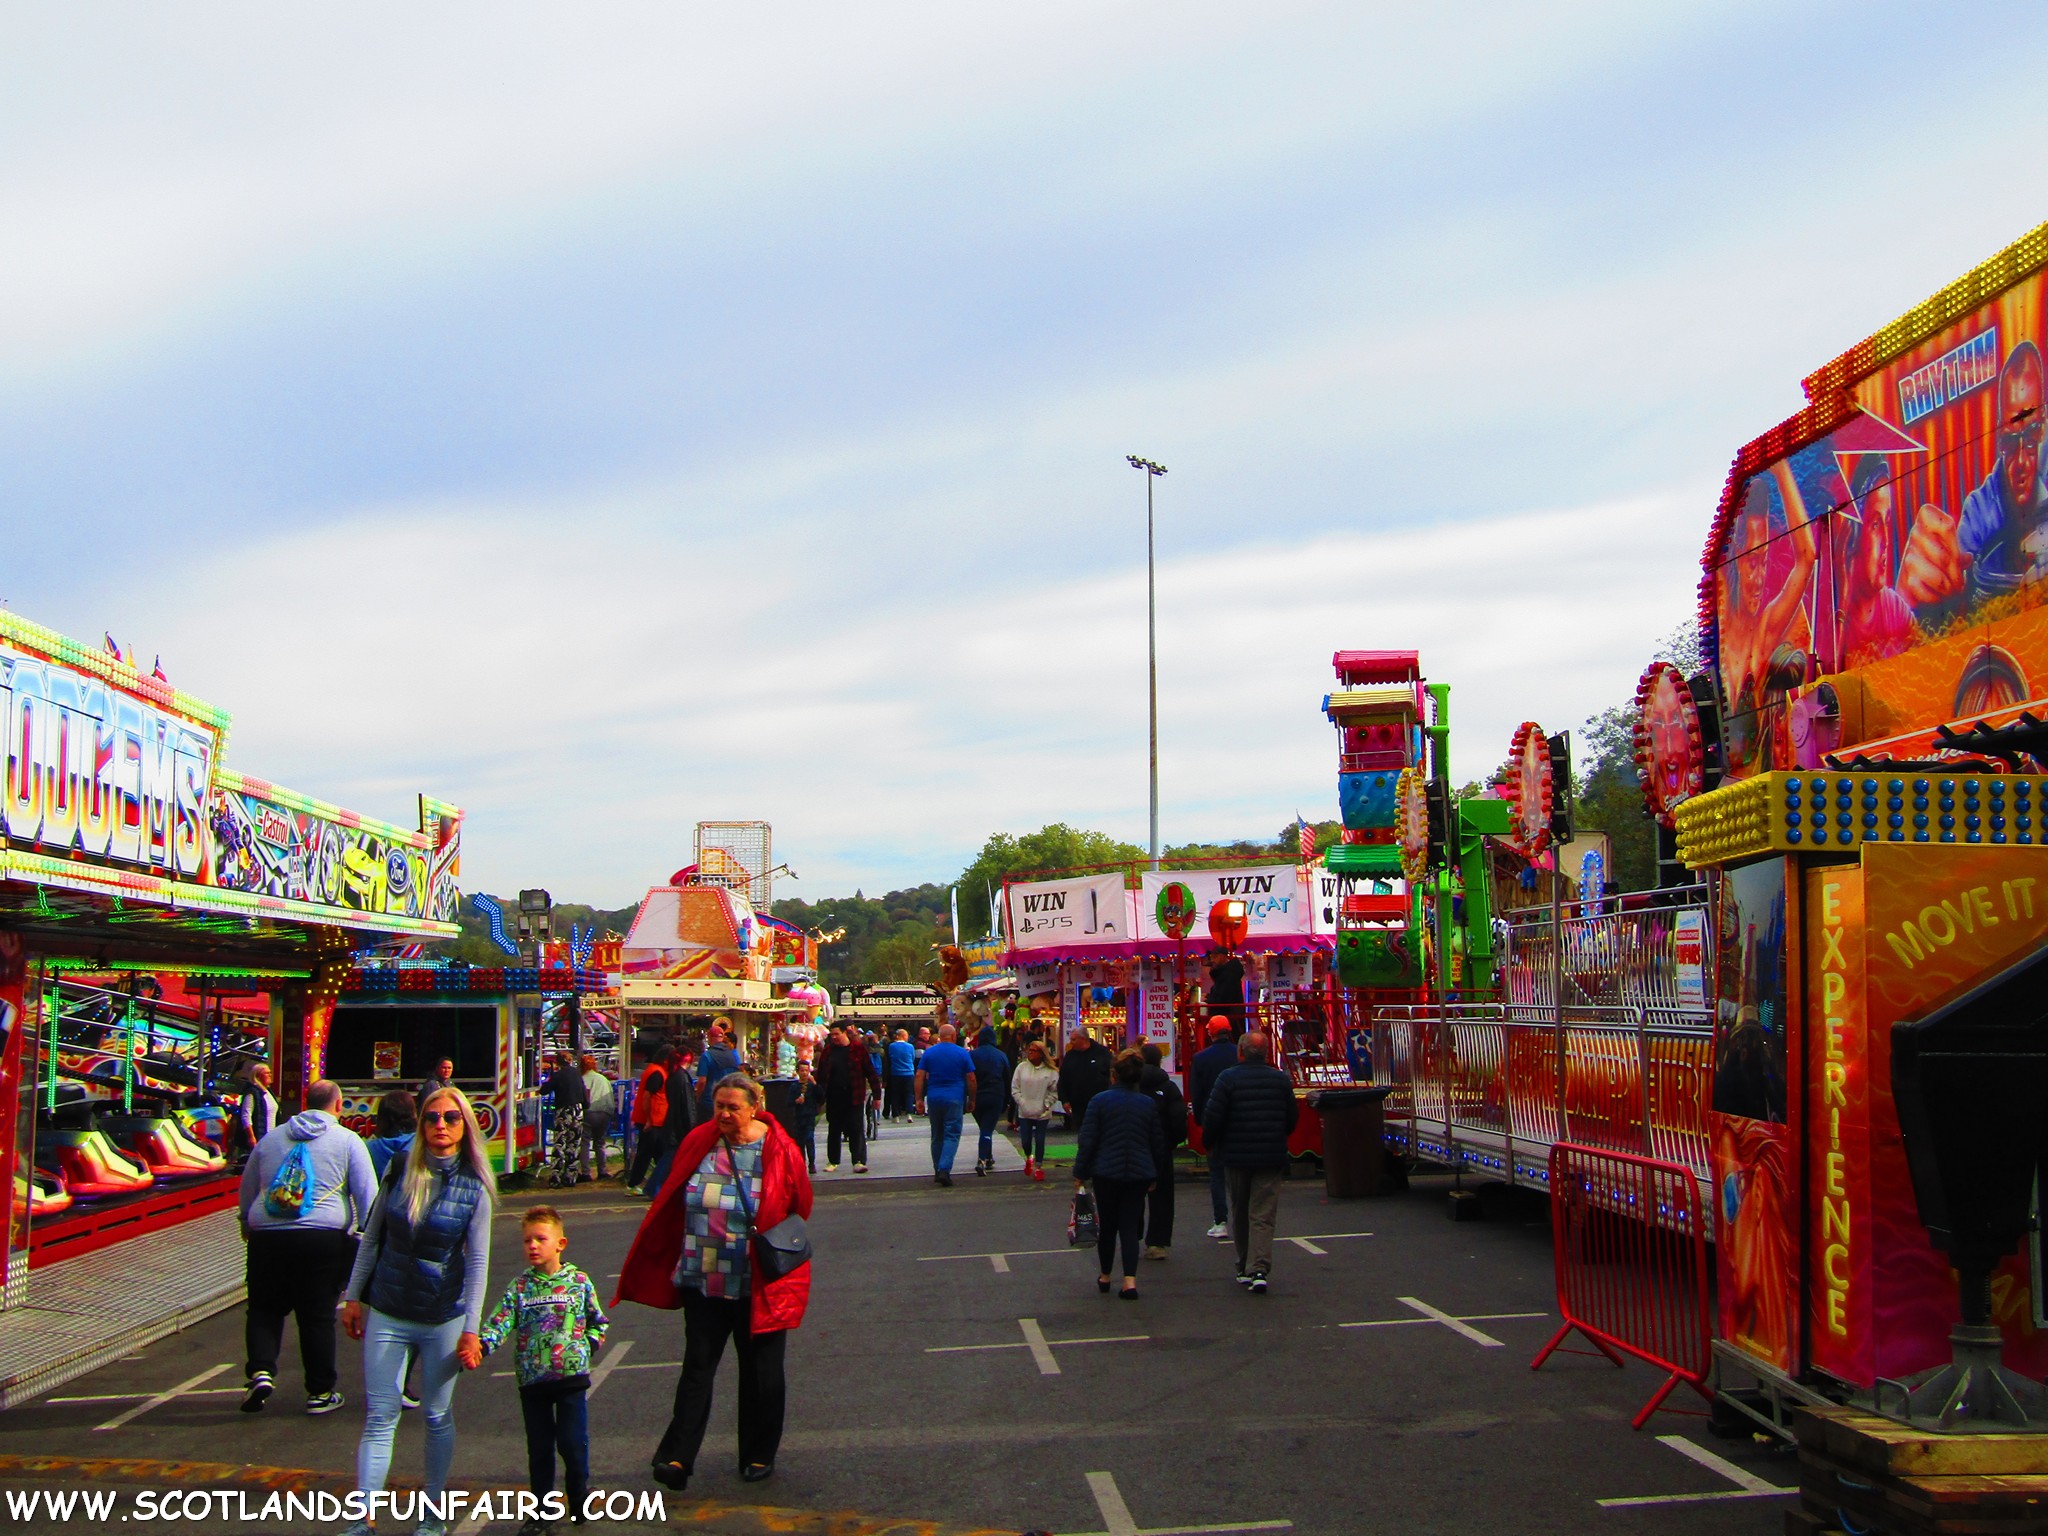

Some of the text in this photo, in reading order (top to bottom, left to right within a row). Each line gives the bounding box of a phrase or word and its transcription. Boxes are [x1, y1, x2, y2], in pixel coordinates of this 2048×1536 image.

[1897, 326, 1997, 426] RHYTHM
[262, 810, 290, 849] Castrol
[390, 858, 406, 883] Ford
[1218, 874, 1276, 896] WIN
[1022, 891, 1068, 914] WIN
[1037, 915, 1073, 930] PS5
[1886, 877, 2038, 970] MOVE IT
[1026, 964, 1049, 977] WIN
[1153, 964, 1165, 983] 1
[1276, 958, 1286, 977] 1
[1032, 978, 1056, 988] iPhone
[1273, 980, 1291, 988] RING
[627, 999, 726, 1007] CHEESE BURGERS HOT DOGS
[855, 997, 903, 1005] BURGERS
[914, 997, 943, 1005] MORE
[1149, 994, 1169, 1002] OVER
[1147, 1012, 1172, 1020] BLOCK
[1153, 1020, 1164, 1028] TO
[1151, 1029, 1168, 1037] WIN
[1819, 882, 1852, 1339] EXPERIENCE
[522, 1294, 576, 1308] MINECRAFT
